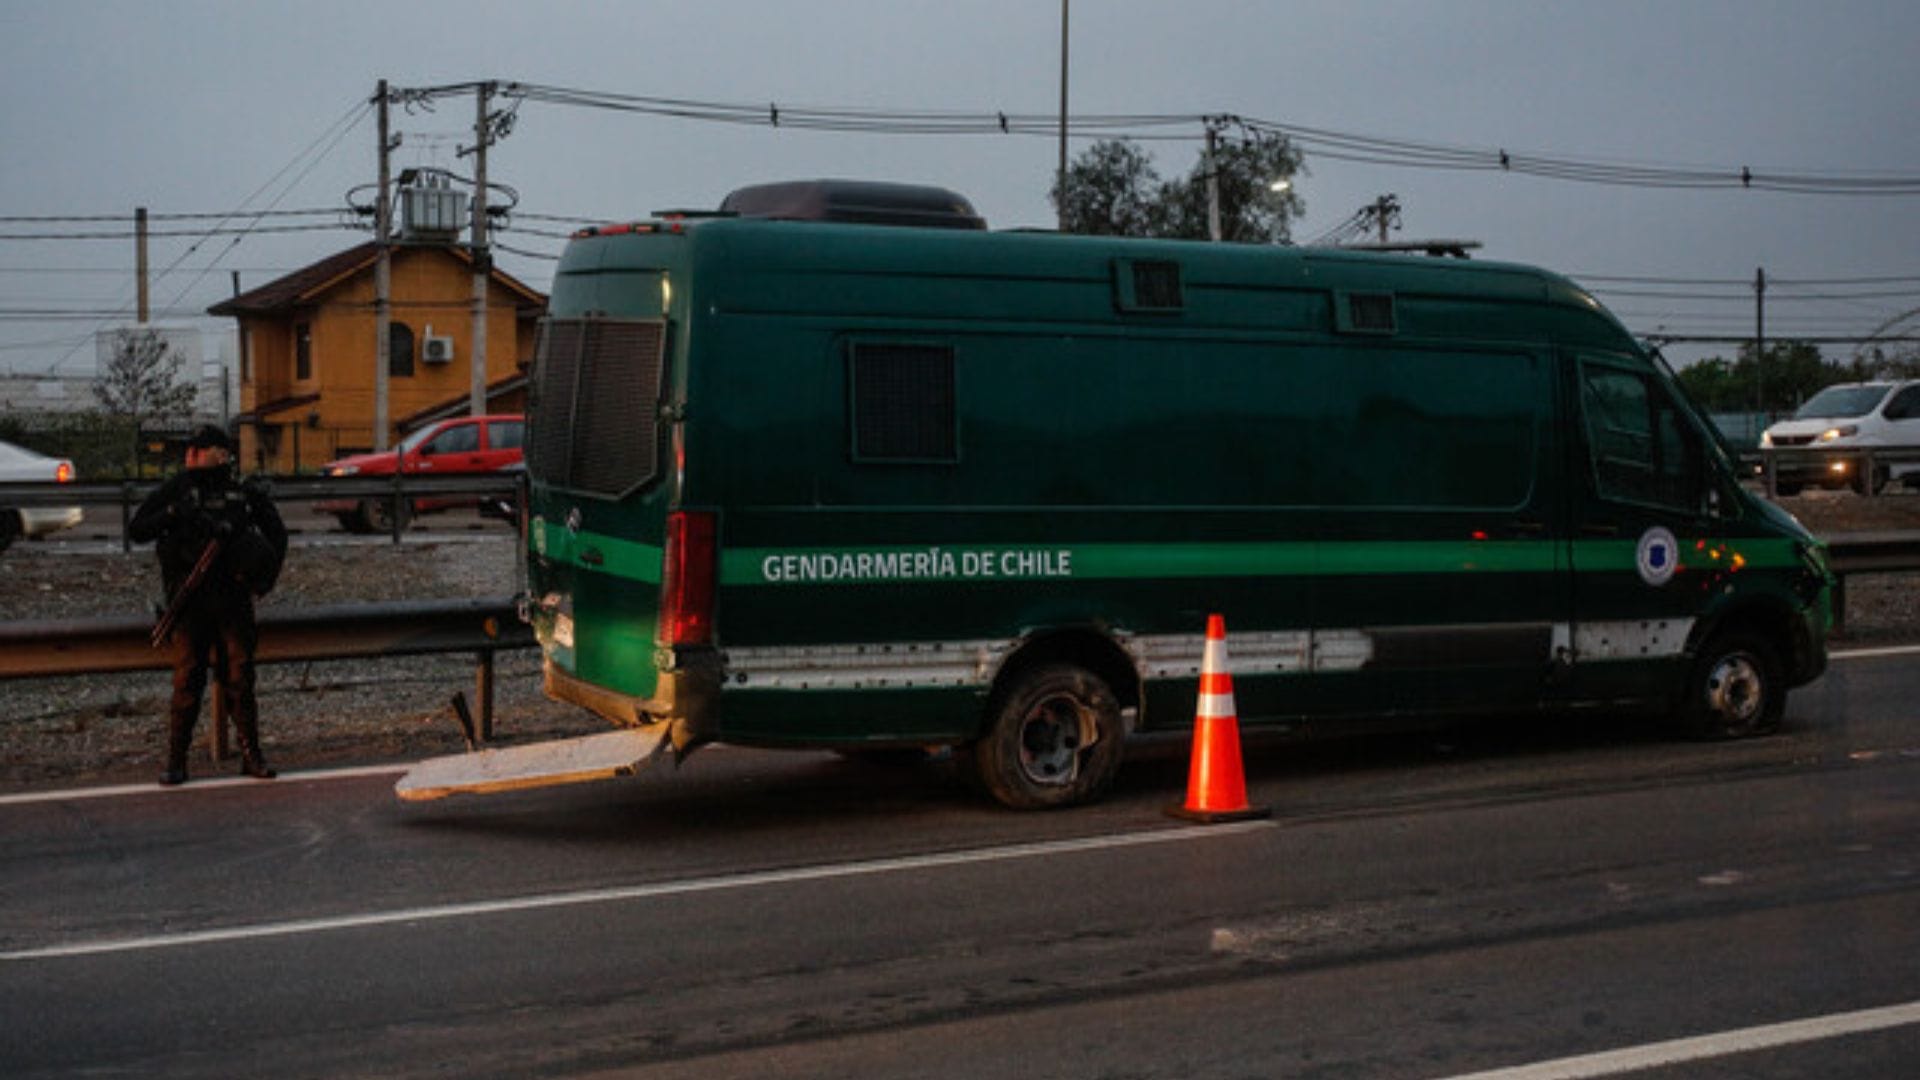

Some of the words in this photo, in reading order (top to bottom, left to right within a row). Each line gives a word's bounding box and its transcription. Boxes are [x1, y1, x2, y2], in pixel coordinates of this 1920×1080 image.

[762, 547, 956, 581] GENDARMERÍA
[962, 551, 995, 576] DE
[1000, 550, 1072, 576] CHILE
